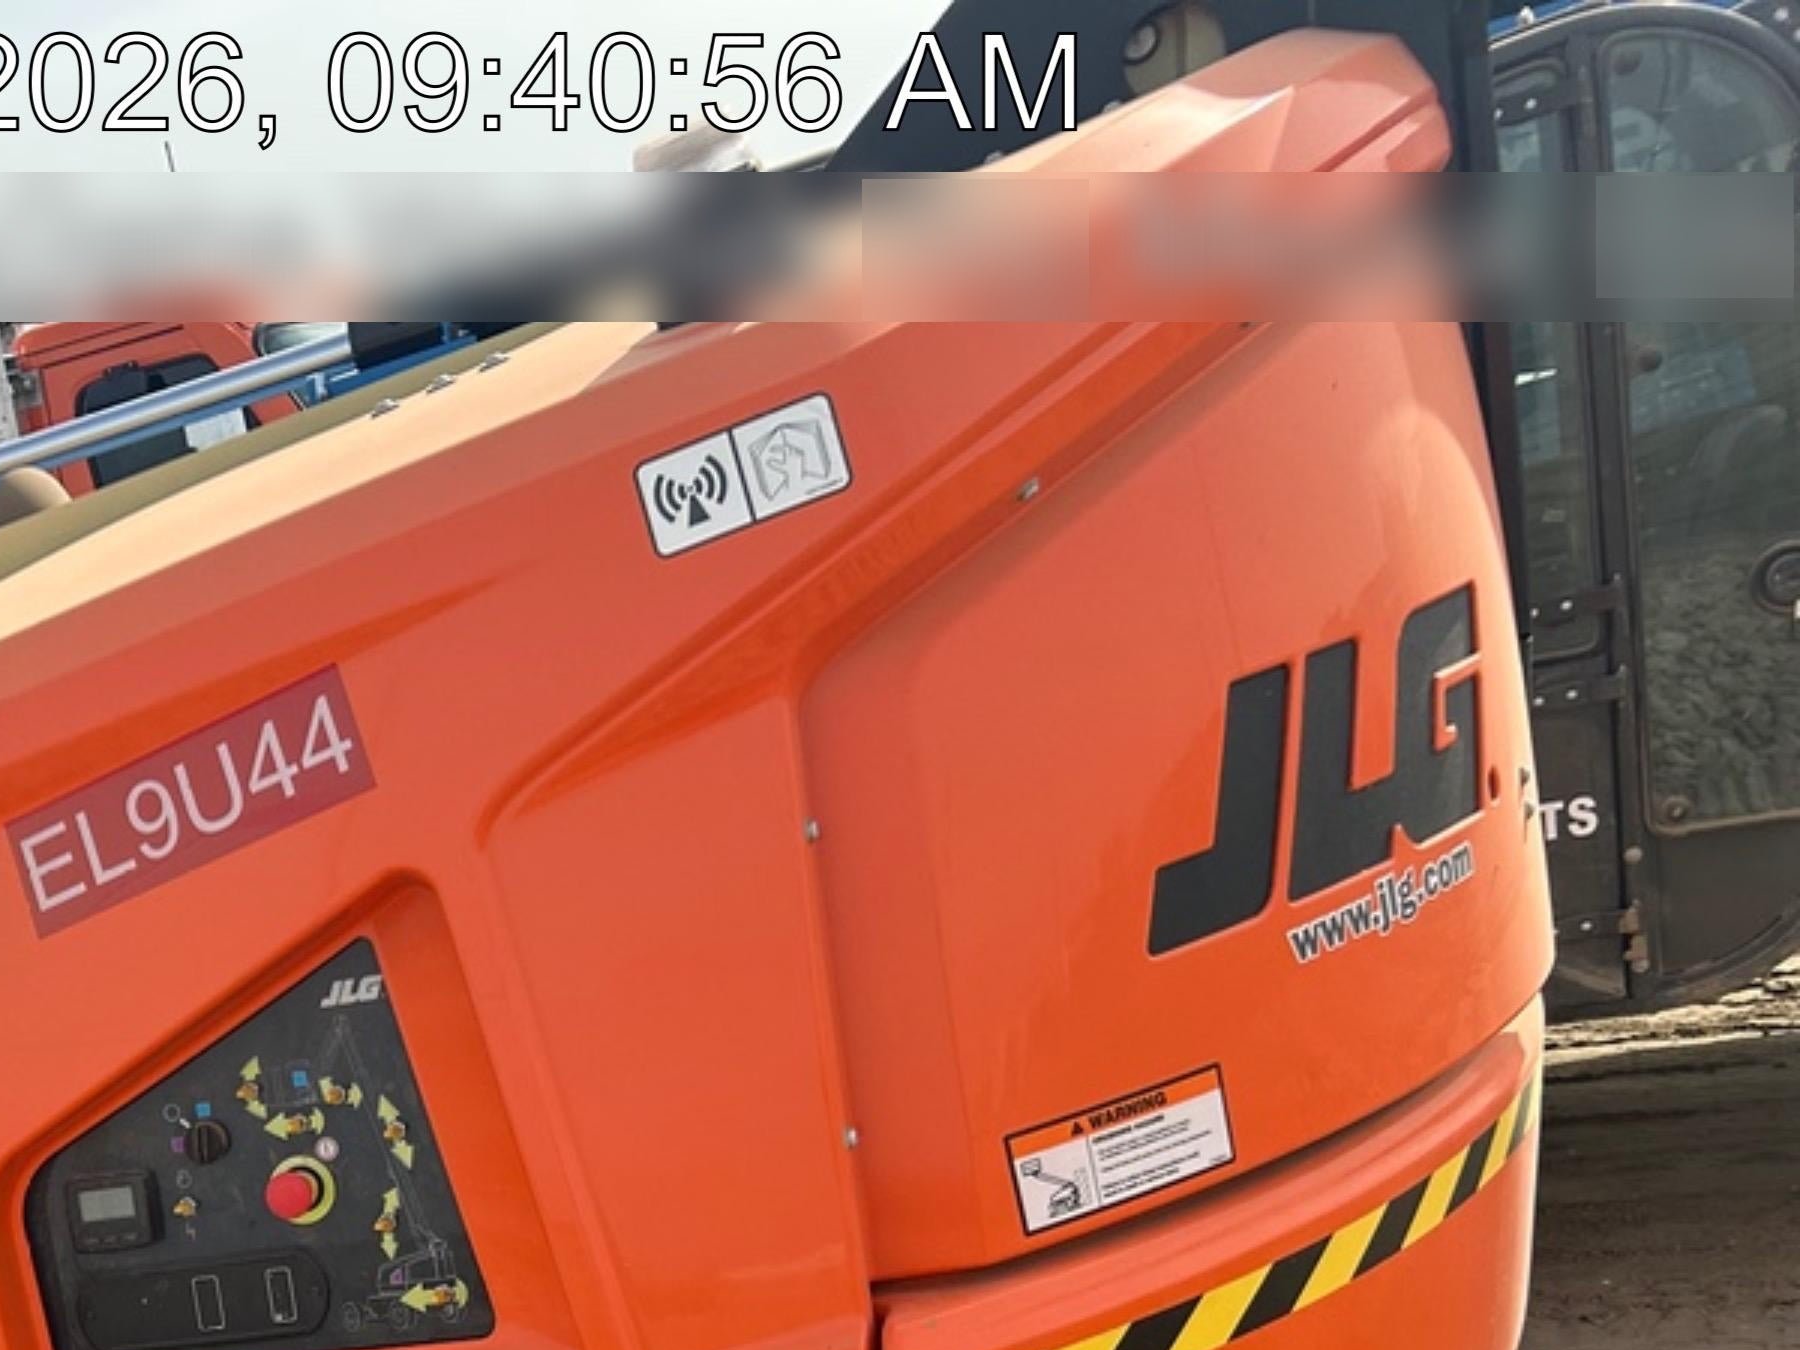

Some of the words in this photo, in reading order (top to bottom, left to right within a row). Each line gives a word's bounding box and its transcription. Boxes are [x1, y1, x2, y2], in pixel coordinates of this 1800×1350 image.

[19, 694, 354, 913] EL9U44
[1148, 578, 1484, 958] JLG
[1288, 842, 1475, 964] www.jlg.com
[319, 974, 383, 1010] JLG
[1088, 1091, 1168, 1130] WARNING
